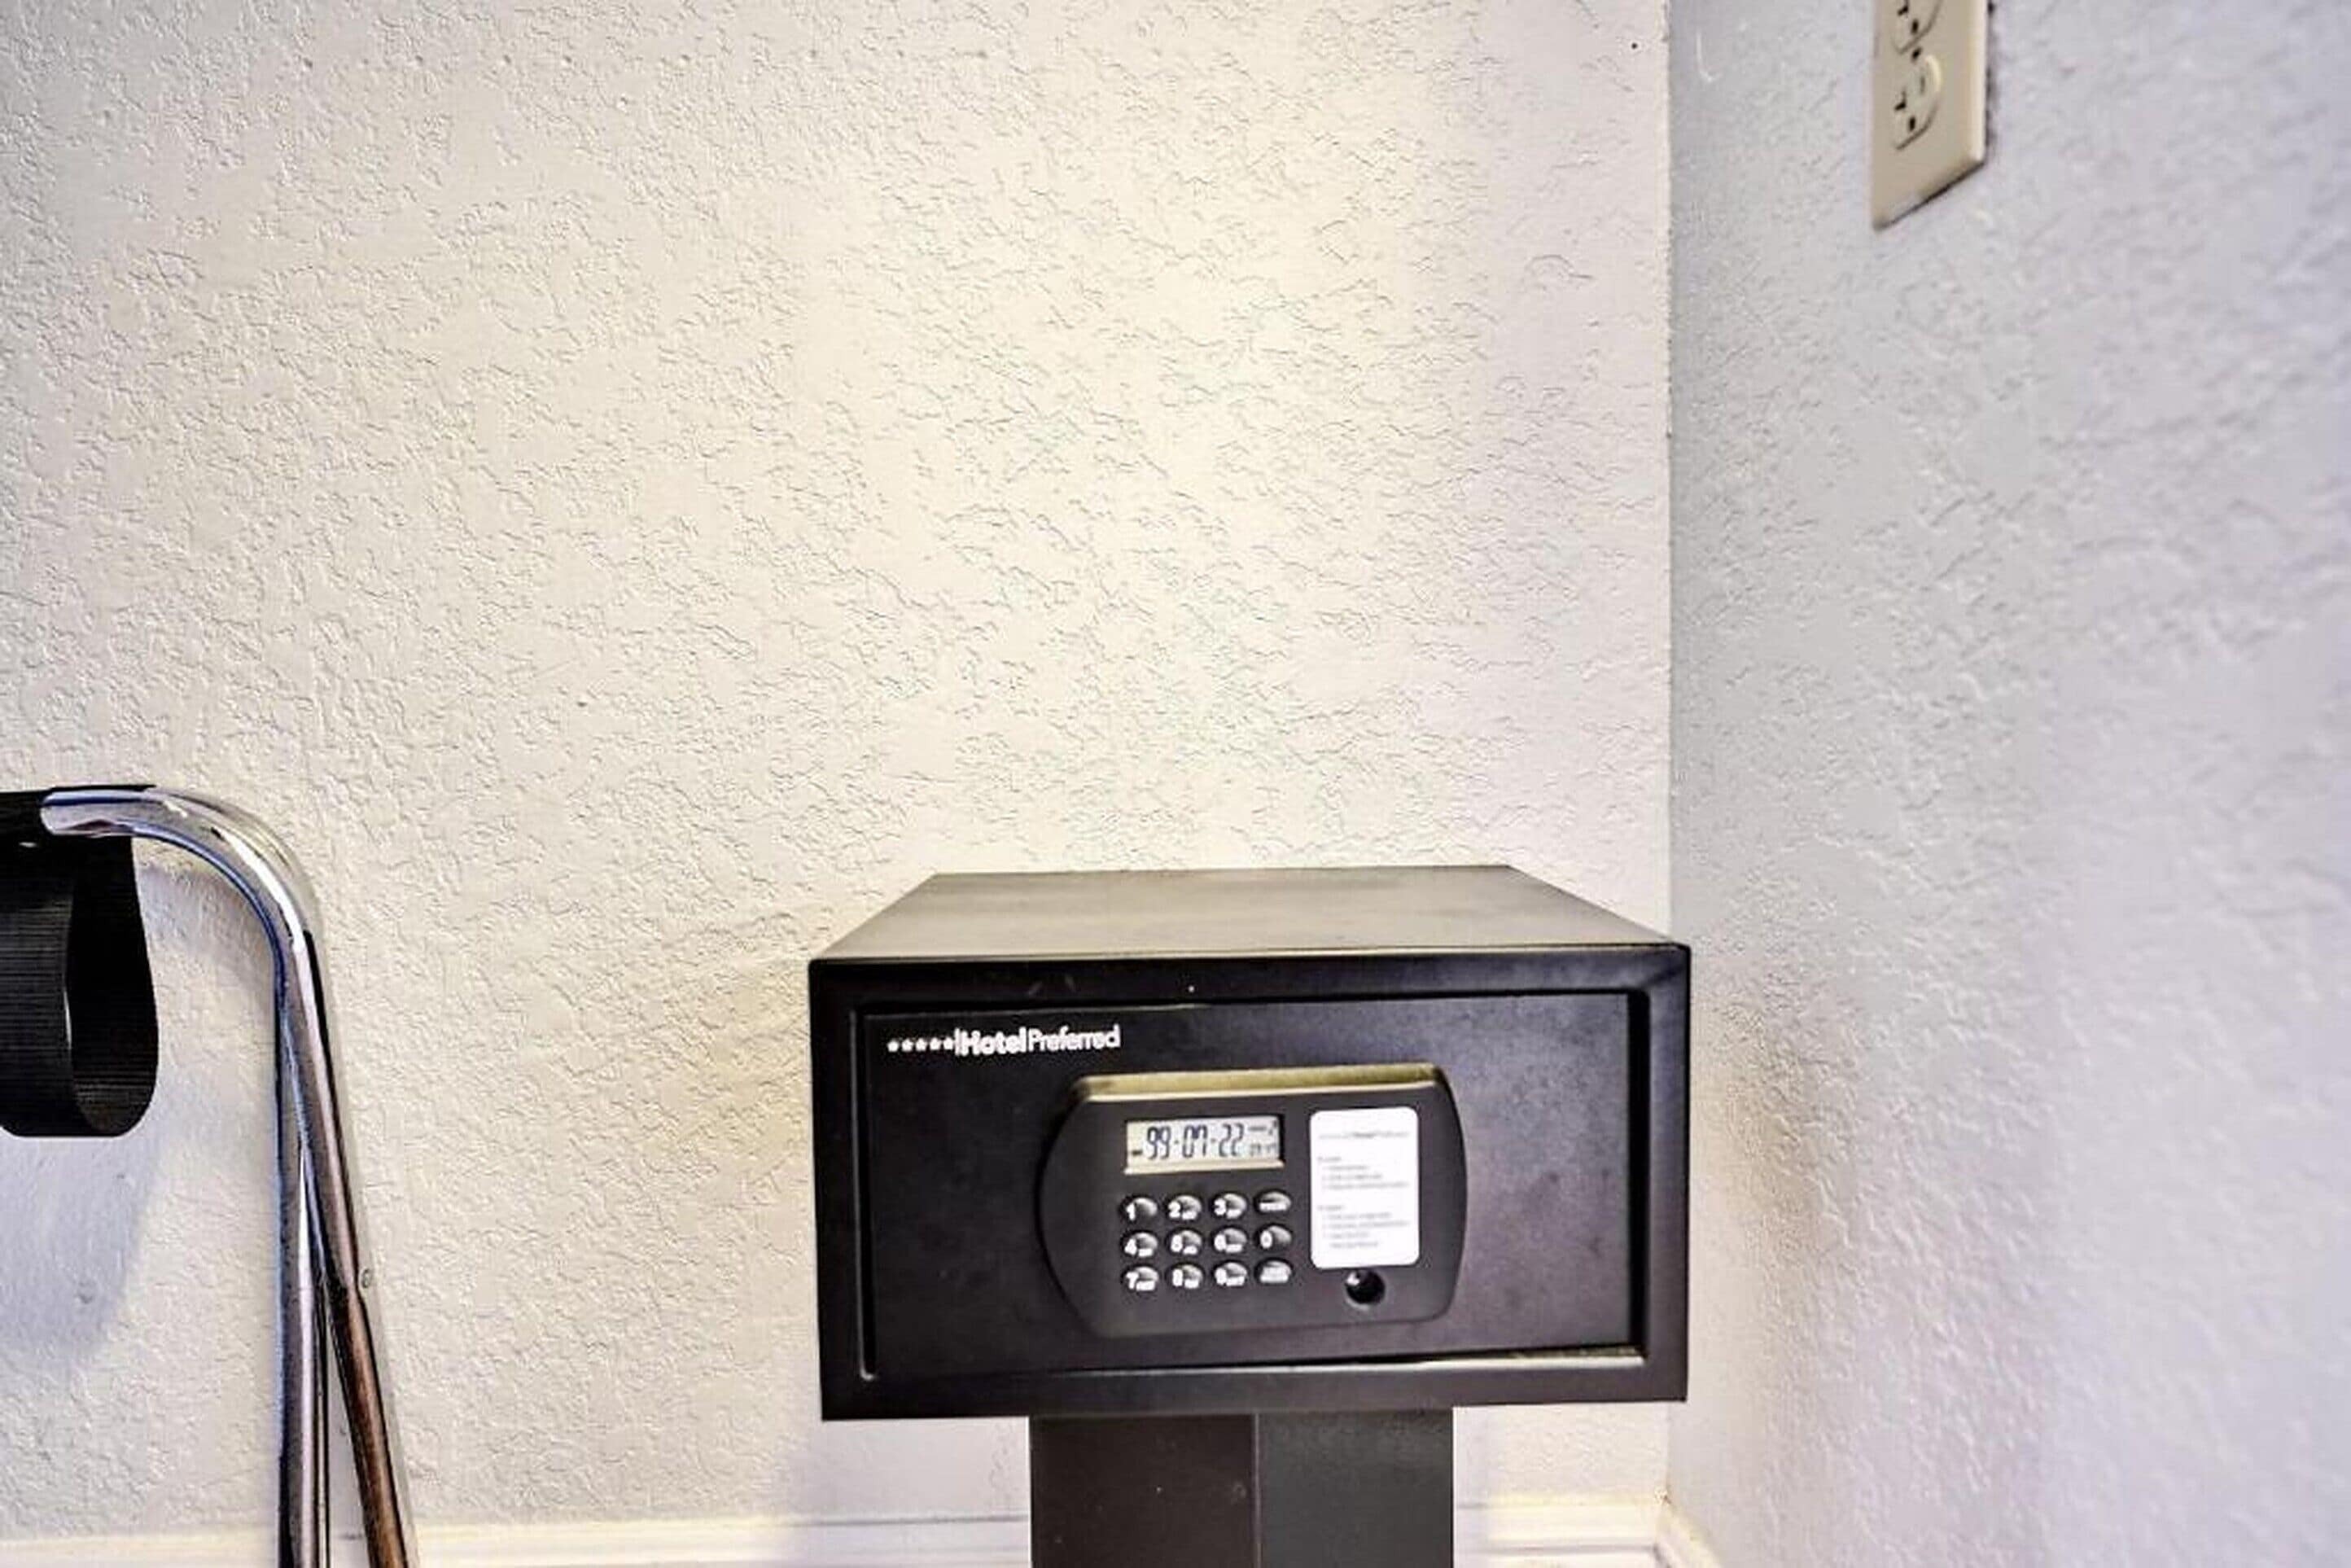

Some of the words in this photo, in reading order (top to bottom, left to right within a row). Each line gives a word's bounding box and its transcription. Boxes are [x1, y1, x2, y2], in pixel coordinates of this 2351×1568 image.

[1127, 1202, 1136, 1220] 1
[1169, 1201, 1180, 1218] 2
[1215, 1199, 1226, 1215] 3
[1125, 1238, 1136, 1255] 4
[1261, 1231, 1272, 1247] 0
[1127, 1272, 1138, 1289] 7
